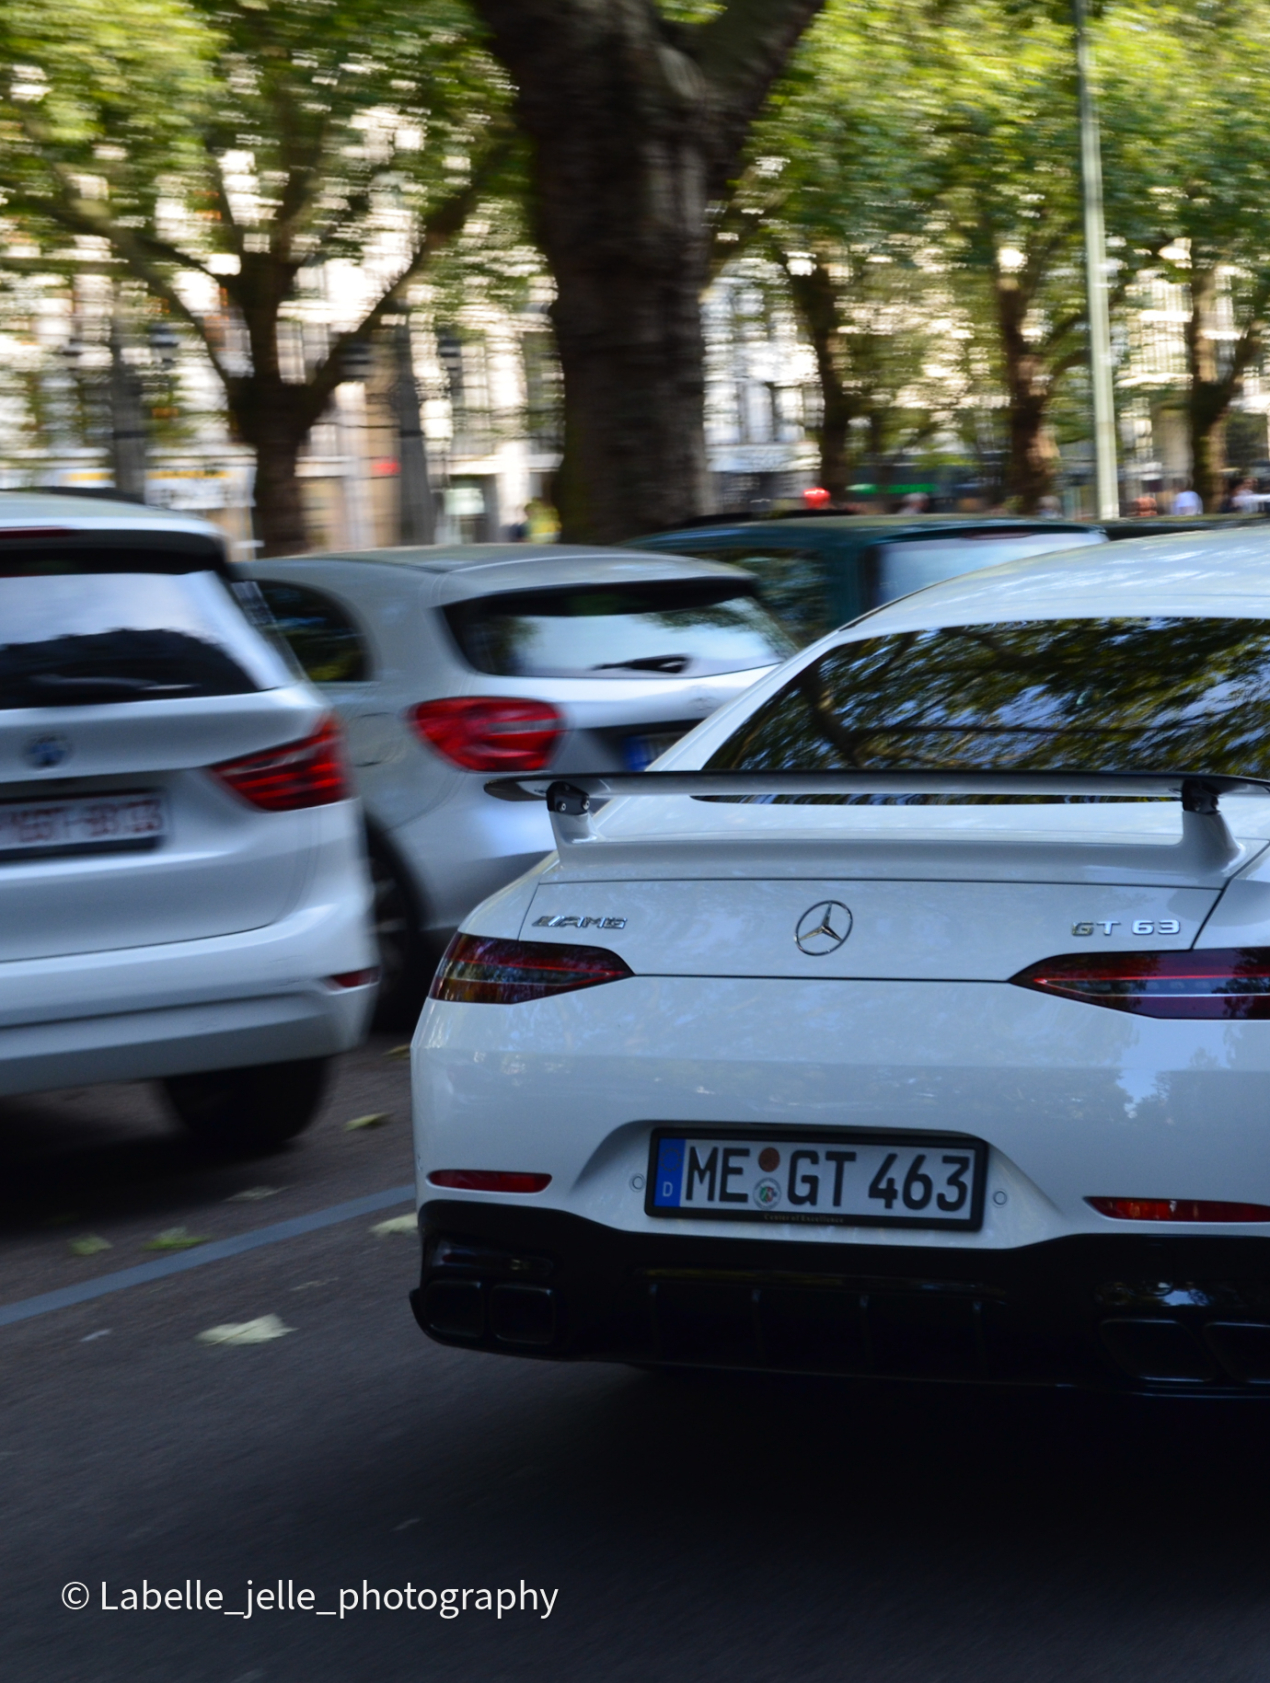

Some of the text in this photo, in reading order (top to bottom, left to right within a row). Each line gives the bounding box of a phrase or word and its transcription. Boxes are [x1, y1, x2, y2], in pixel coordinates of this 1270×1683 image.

[1071, 919, 1180, 936] GT 63
[686, 1146, 750, 1203] ME
[787, 1149, 857, 1207] GT
[868, 1152, 971, 1211] 463
